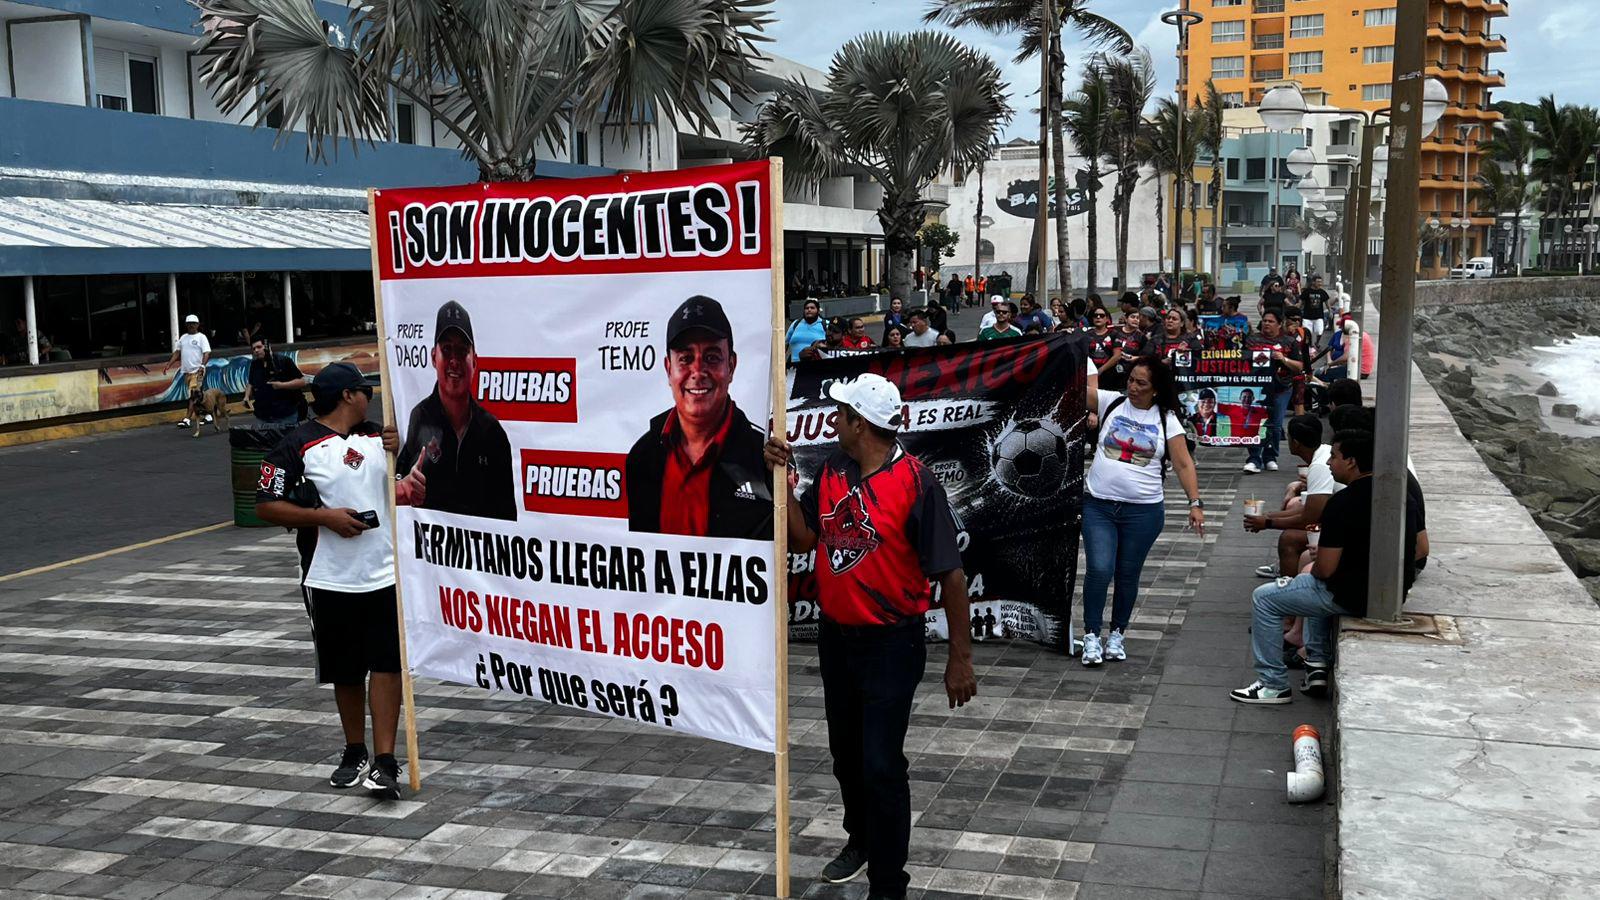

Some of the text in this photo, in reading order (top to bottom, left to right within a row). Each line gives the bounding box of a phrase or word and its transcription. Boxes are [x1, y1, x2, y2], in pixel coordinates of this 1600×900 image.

[397, 323, 424, 339] PROFE
[605, 321, 649, 339] PROFE
[395, 345, 428, 369] DAGO
[598, 344, 656, 372] TEMO
[1201, 349, 1242, 359] EXIGIMOS
[1195, 360, 1252, 374] JUSTICIA
[477, 371, 571, 403] PRUEBAS
[917, 408, 938, 426] ES
[943, 404, 984, 423] REAL
[934, 461, 958, 471] PROFE
[935, 469, 964, 484] EMO
[525, 464, 622, 501] PRUEBAS
[734, 491, 756, 500] adidas
[413, 519, 544, 582] PERMITANOS
[550, 540, 647, 593] LLEGAR
[655, 549, 676, 595] A
[680, 552, 768, 605] ELLAS
[439, 585, 724, 671] NOS NIEGAN EL ACCESO
[538, 666, 588, 709] que
